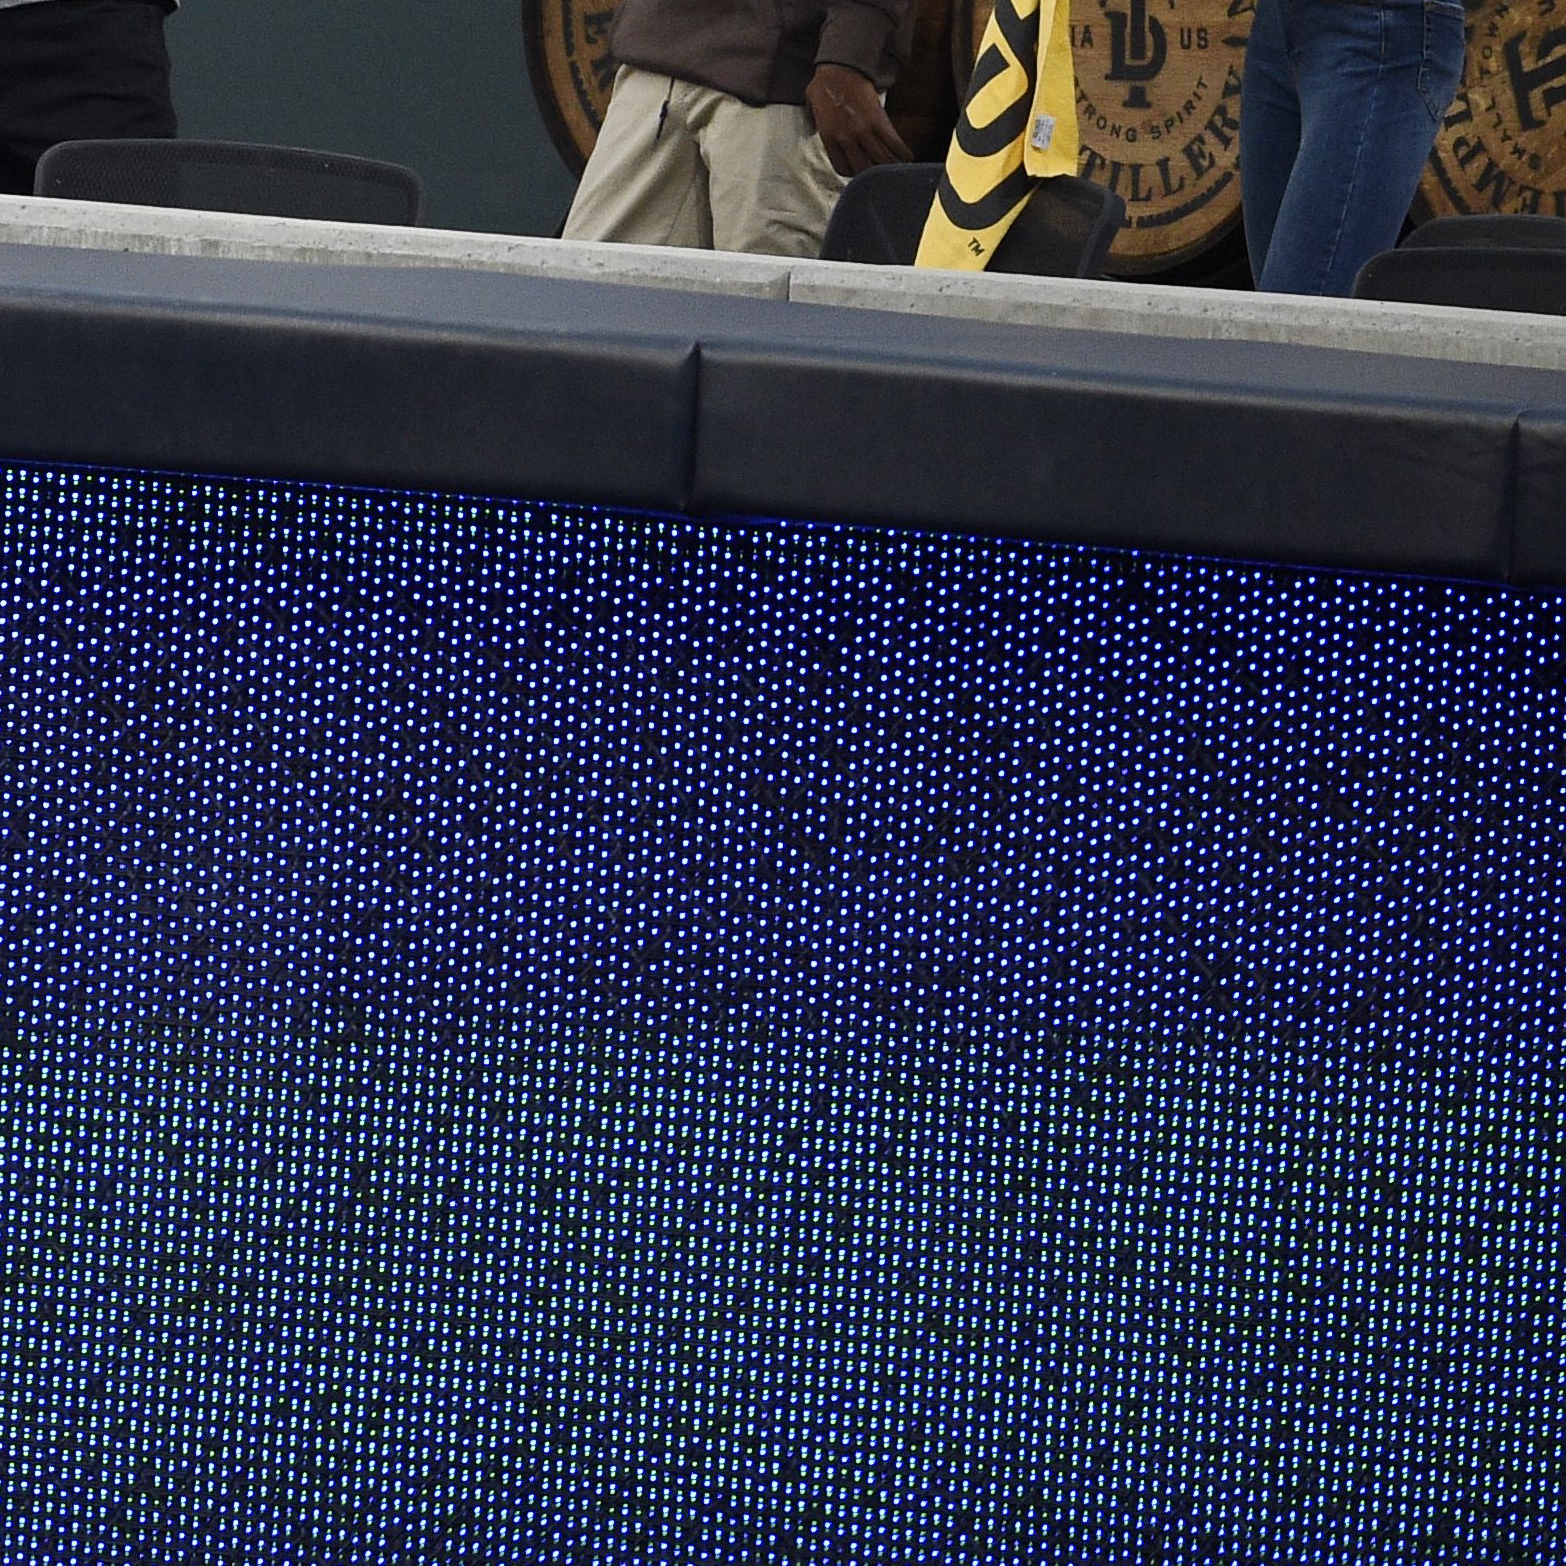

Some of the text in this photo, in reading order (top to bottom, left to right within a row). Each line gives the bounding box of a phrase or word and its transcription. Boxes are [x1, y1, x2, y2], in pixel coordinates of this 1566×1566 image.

[1179, 26, 1209, 51] US
[1077, 63, 1242, 202] TILLERY
[1149, 75, 1209, 140] SPIRIT
